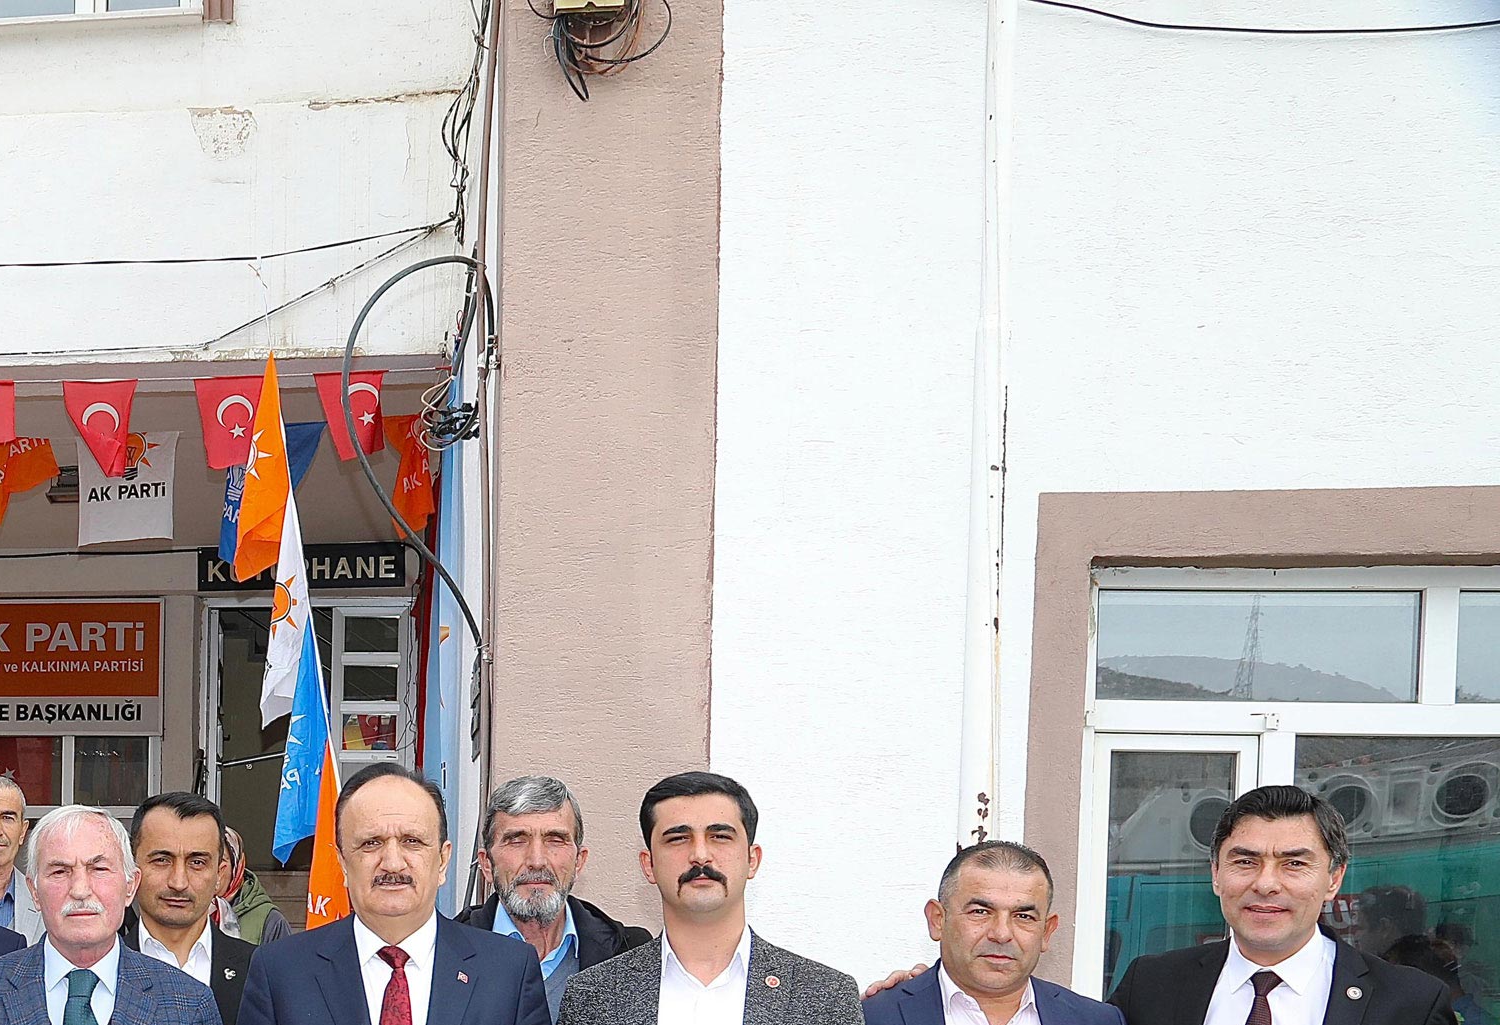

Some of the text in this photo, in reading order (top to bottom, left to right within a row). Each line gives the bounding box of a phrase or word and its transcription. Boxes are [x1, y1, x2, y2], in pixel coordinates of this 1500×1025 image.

[88, 485, 112, 503] AK
[25, 621, 145, 652] PARTi
[4, 663, 18, 673] ve
[22, 660, 90, 673] KALKINMA
[94, 657, 144, 672] PARTİSİ
[16, 699, 142, 726] BAŞKANLIĞI
